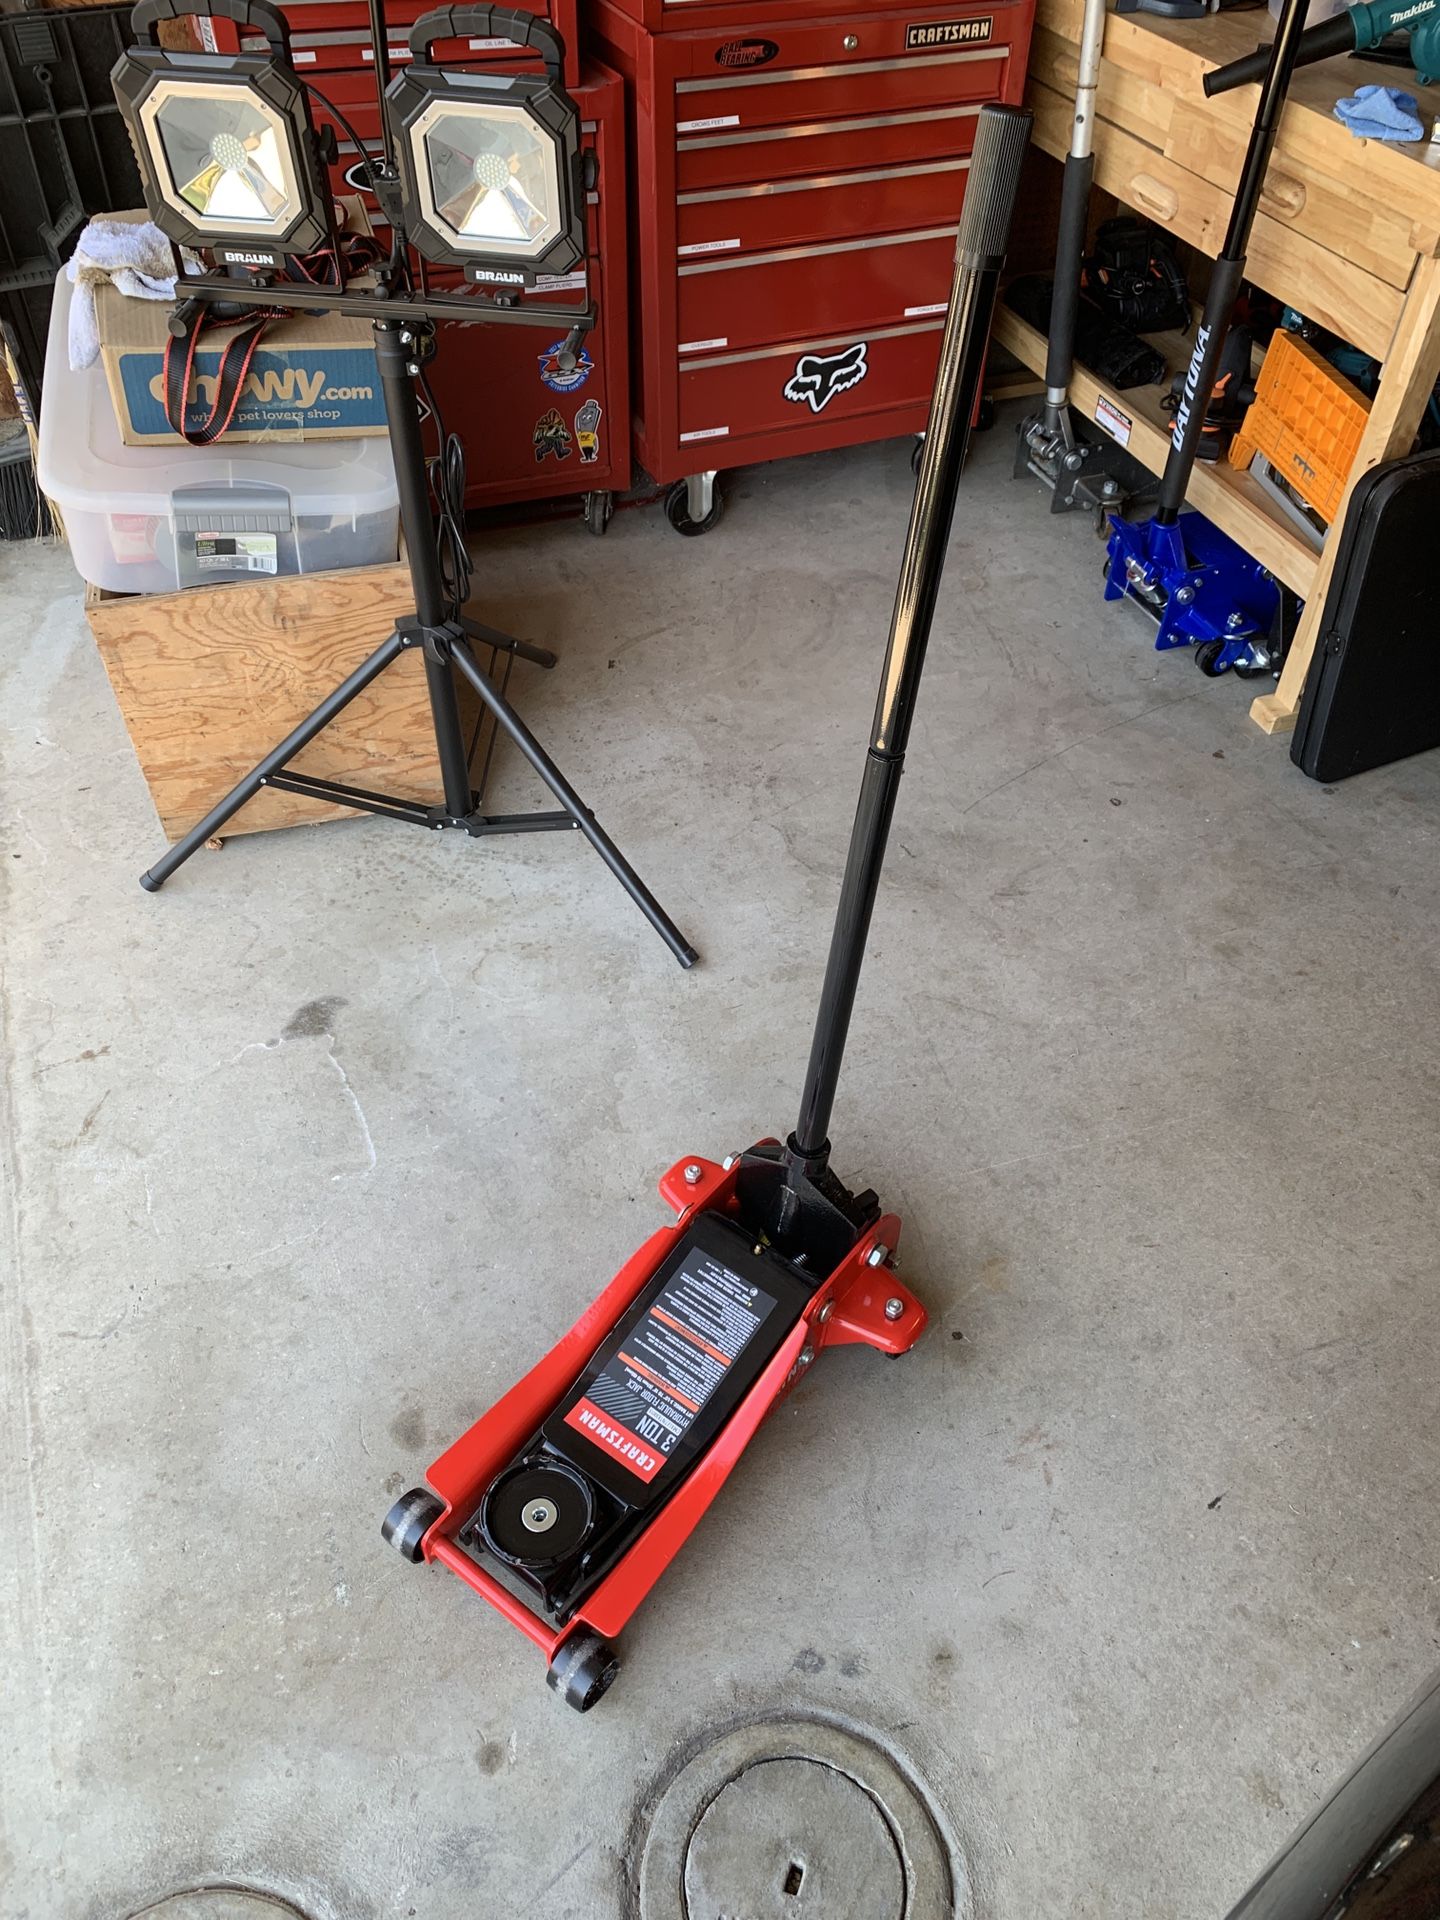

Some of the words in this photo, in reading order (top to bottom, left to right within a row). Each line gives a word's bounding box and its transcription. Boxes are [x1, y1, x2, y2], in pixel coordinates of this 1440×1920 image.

[909, 22, 990, 45] CRAFTSMAN
[719, 51, 756, 66] BEARING
[224, 251, 274, 265] BRAUN
[475, 270, 524, 284] BRAUN
[149, 364, 372, 408] chwy.com
[238, 409, 260, 423] pet
[262, 410, 304, 421] lovers
[307, 408, 341, 420] shop
[624, 1377, 643, 1394] JACK
[639, 1387, 661, 1407] FLOOR
[656, 1400, 690, 1428] HYDRAULIC
[633, 1413, 666, 1445] TON
[577, 1408, 657, 1473] CRAFTSMAN
[659, 1432, 677, 1453] 3
